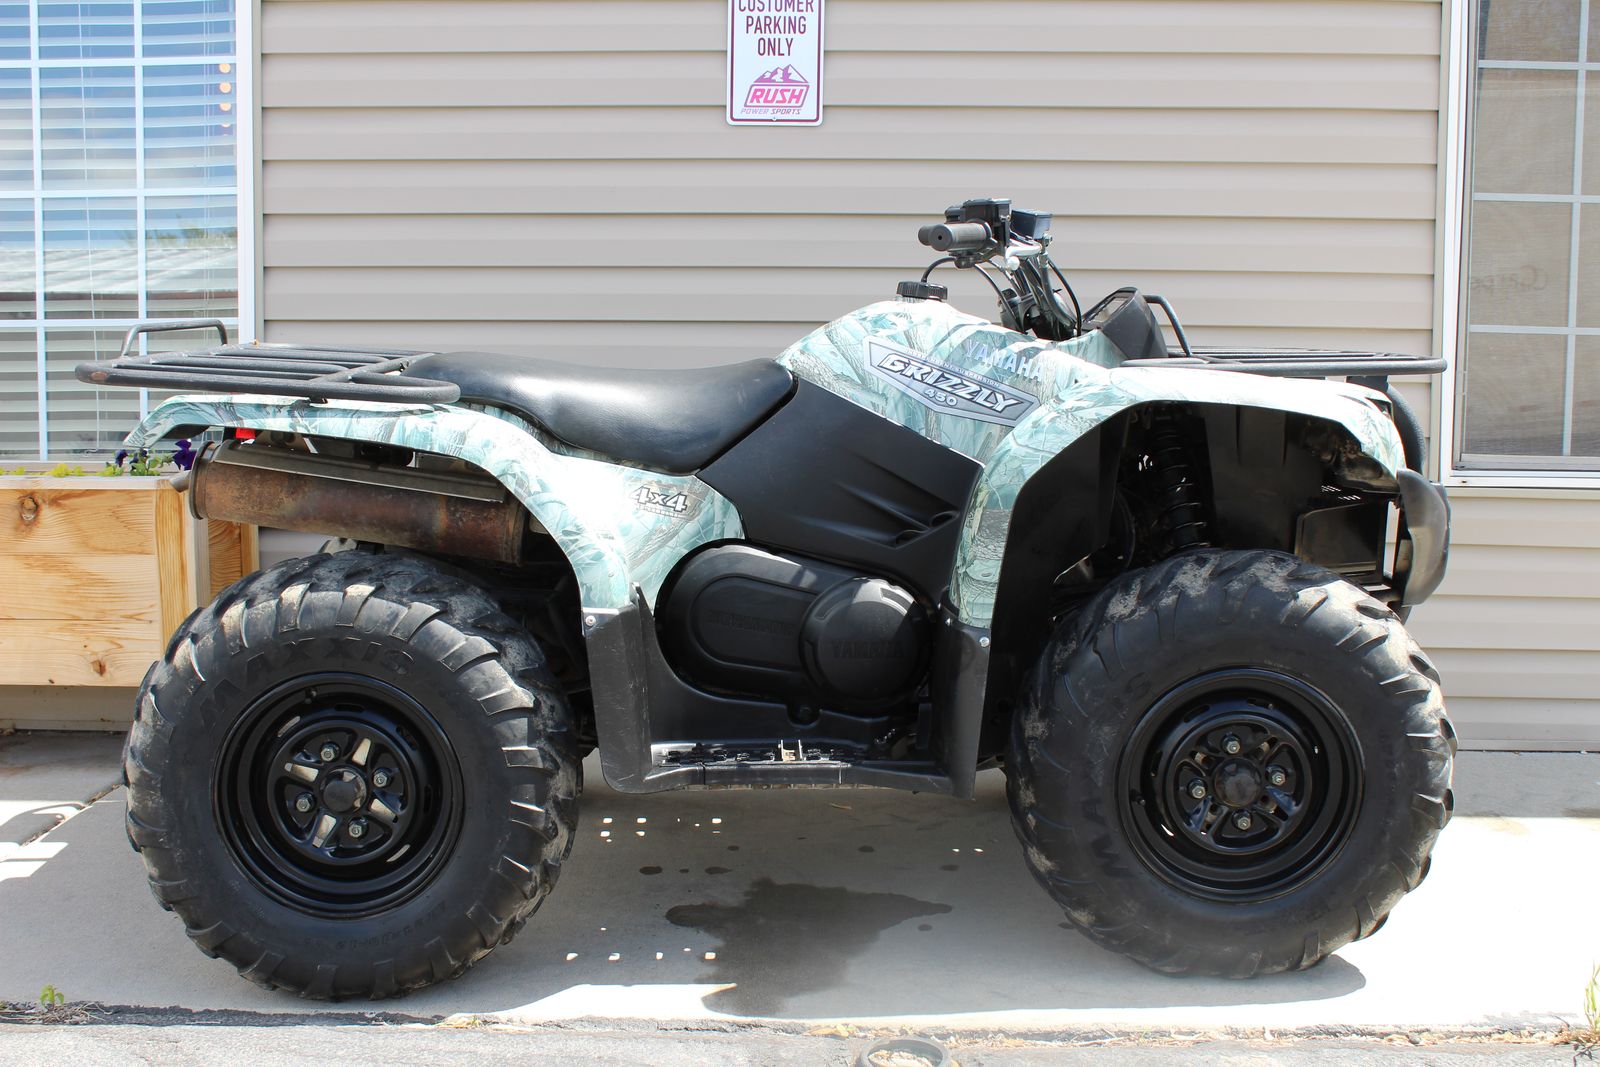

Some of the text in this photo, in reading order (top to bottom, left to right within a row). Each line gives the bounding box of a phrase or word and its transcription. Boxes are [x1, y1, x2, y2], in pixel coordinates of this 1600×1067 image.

[738, 0, 814, 12] CUSTOMER
[745, 15, 807, 34] PARKING
[757, 37, 794, 56] ONLY
[749, 88, 804, 104] RUSH
[966, 339, 1046, 382] YAMAHA
[877, 353, 1024, 413] GRIZZLY
[923, 388, 957, 406] 450
[628, 486, 688, 512] 4x4
[199, 637, 415, 728] MAXXIS
